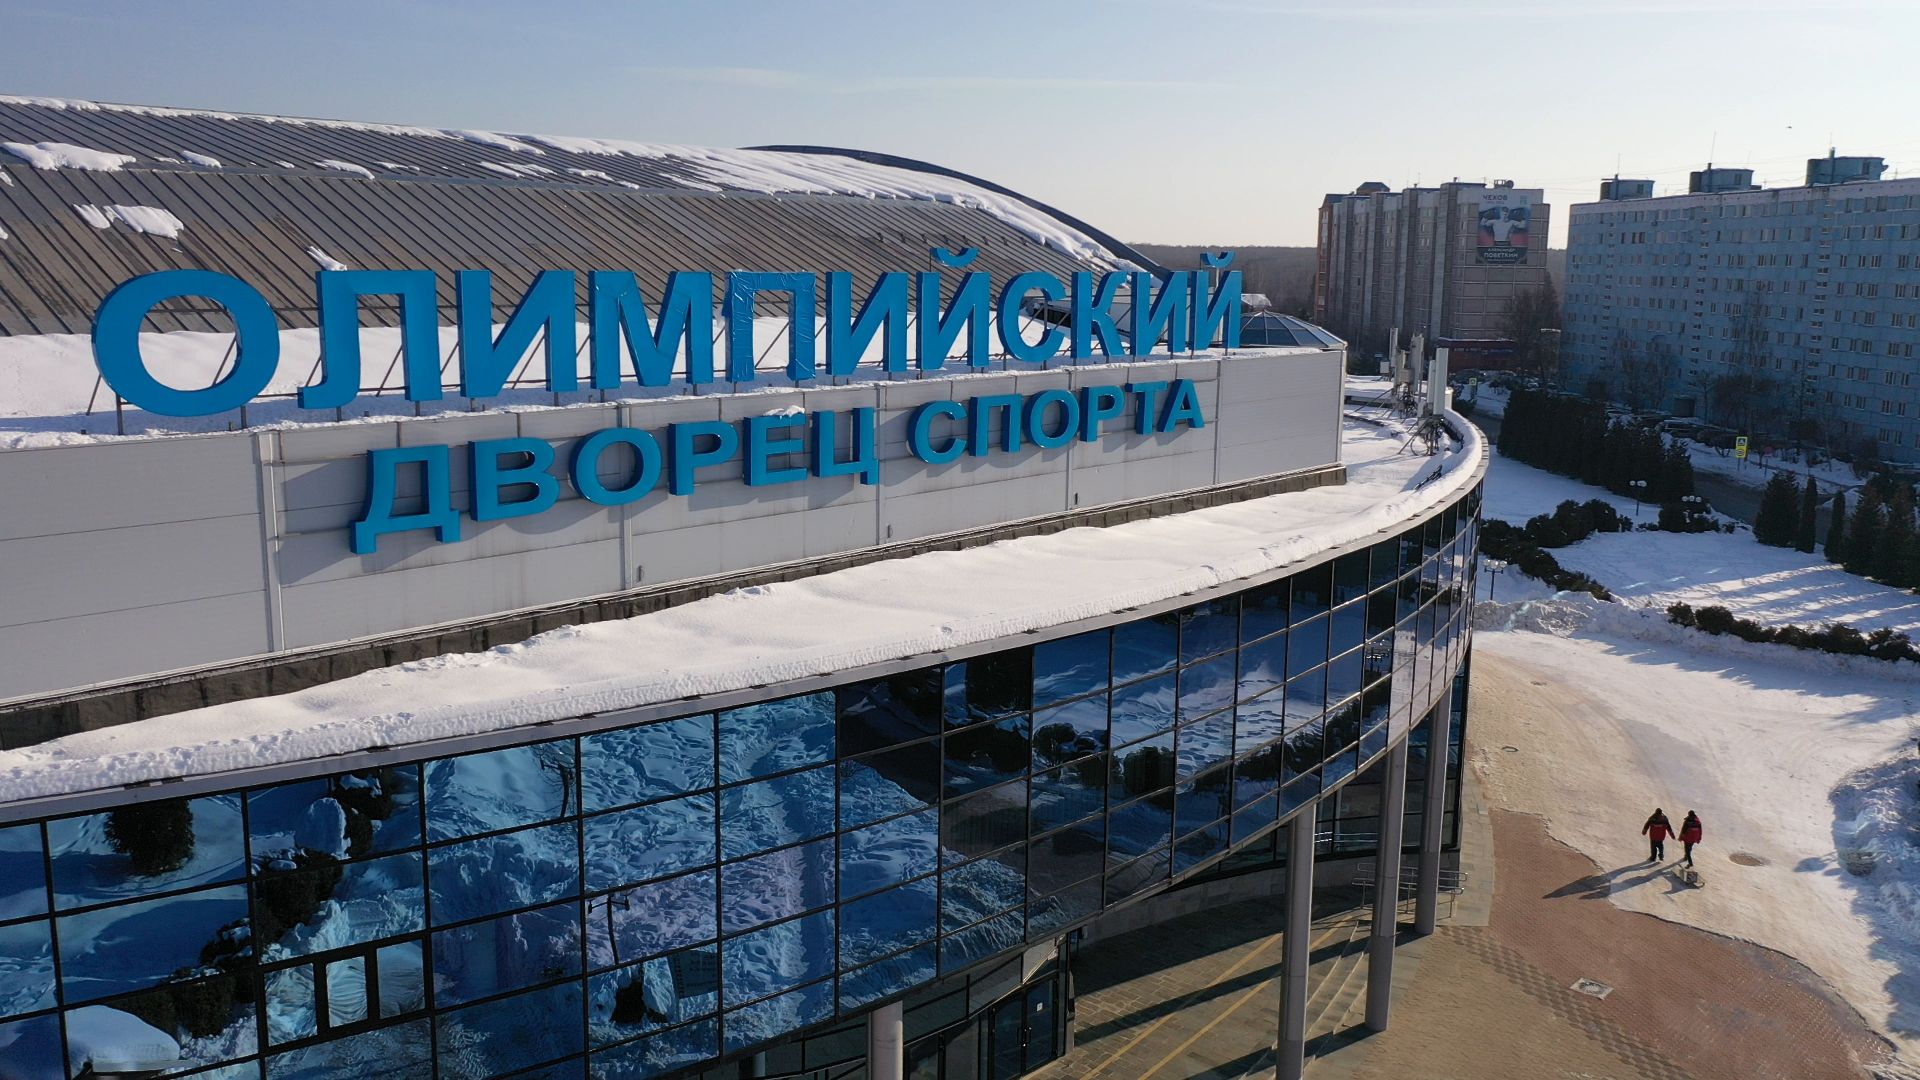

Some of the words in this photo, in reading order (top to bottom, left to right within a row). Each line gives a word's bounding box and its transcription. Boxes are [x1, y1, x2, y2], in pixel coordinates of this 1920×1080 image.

[91, 246, 1243, 417] ОЛИМПИЙСКИЙ
[350, 406, 880, 555] ДВОРЕЦ
[906, 378, 1205, 465] СПОРТА
